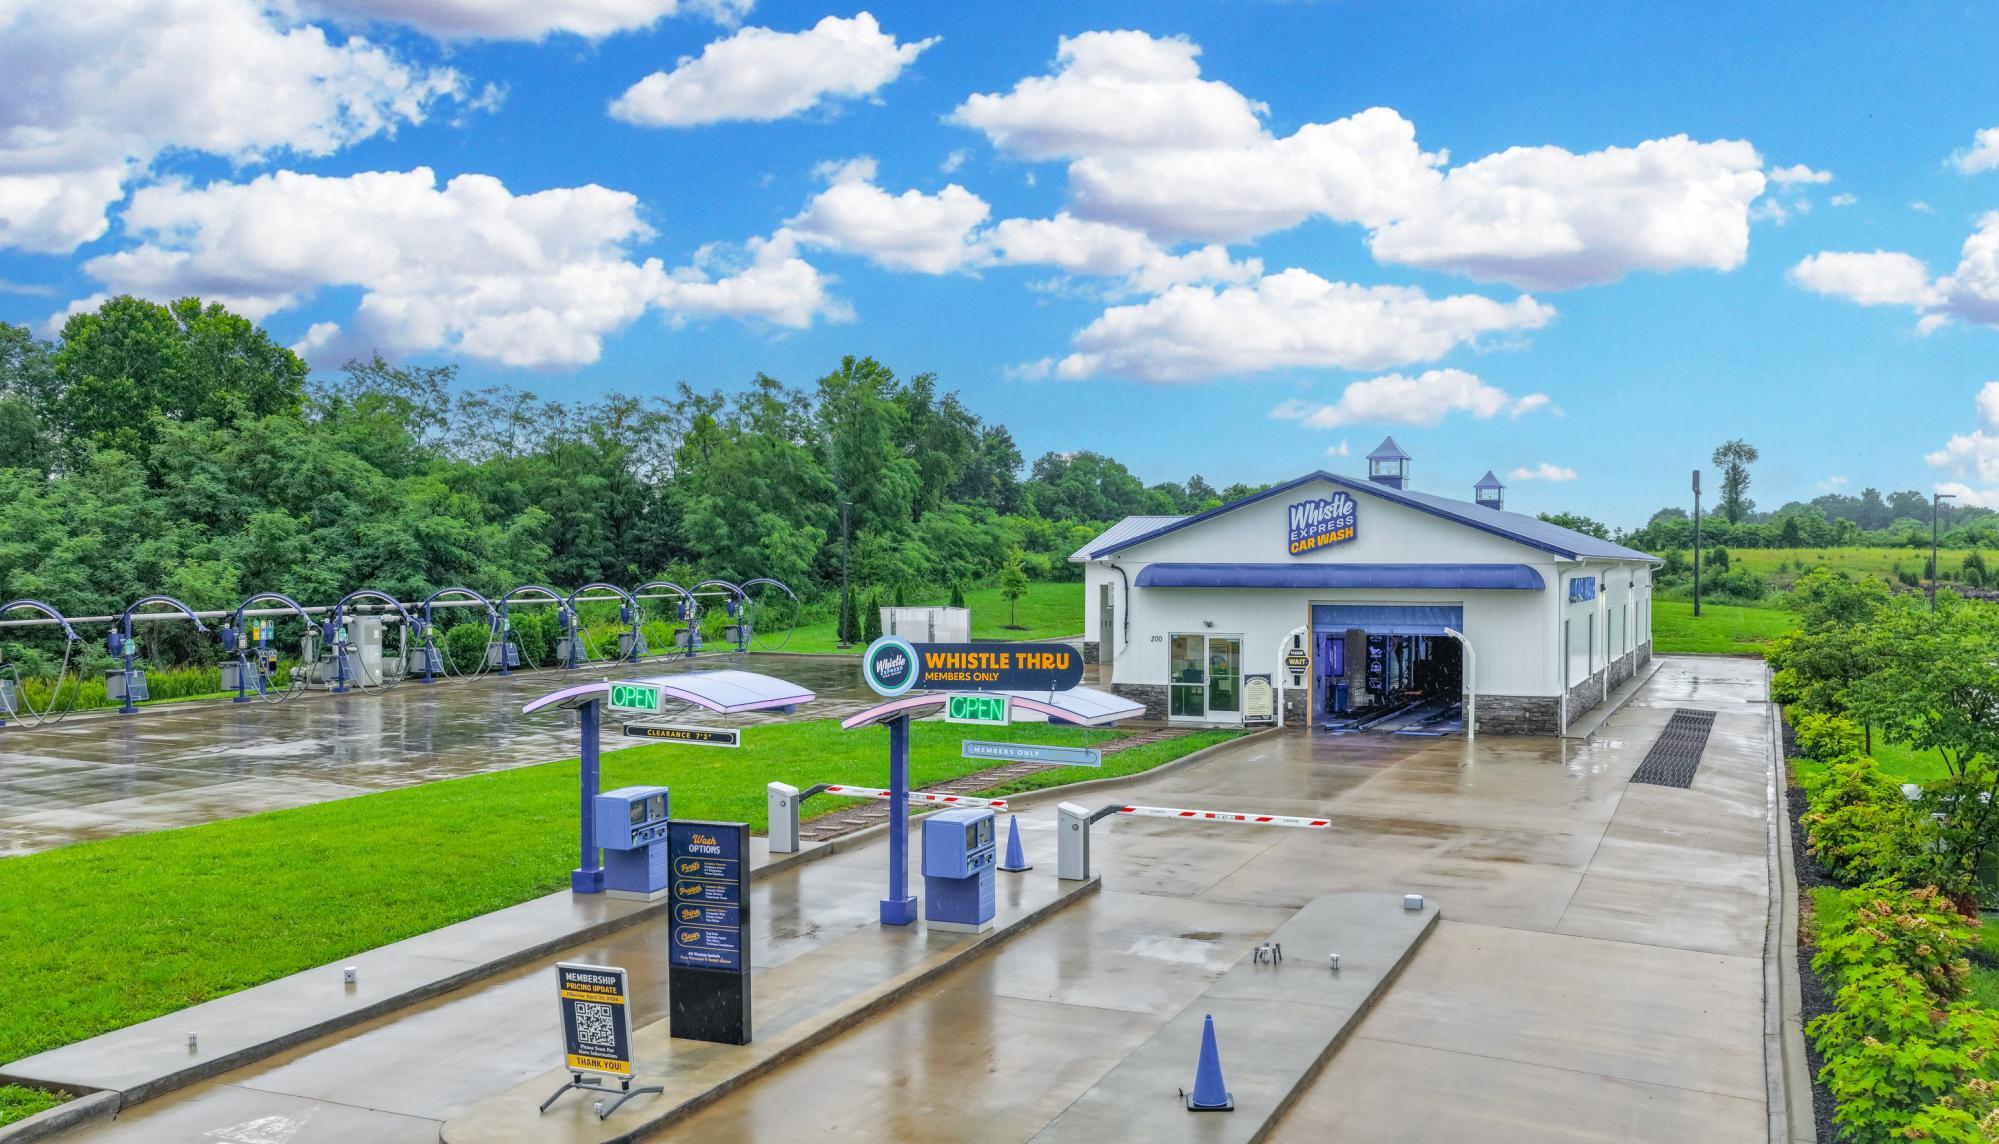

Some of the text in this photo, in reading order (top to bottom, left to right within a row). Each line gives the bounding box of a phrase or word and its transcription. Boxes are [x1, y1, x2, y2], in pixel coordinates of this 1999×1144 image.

[1290, 493, 1354, 531] Whistle
[1291, 515, 1354, 541] EXPRESS
[1290, 526, 1354, 554] CAR WASH
[876, 654, 906, 673] Whistle
[925, 652, 1070, 669] WHISTLE THRU
[925, 671, 1000, 681] MEMBERS ONLY
[613, 686, 656, 709] OPEN
[951, 696, 1003, 721] OPEN
[647, 729, 691, 739] CLEARANCE
[974, 746, 1014, 756] MEMBERS
[692, 834, 718, 845] Wash
[688, 844, 721, 855] OPTIONS
[565, 972, 616, 985] MEMBERSHIP
[566, 982, 618, 995] PRICING UPDATE
[576, 1057, 622, 1071] THANK YOU!
